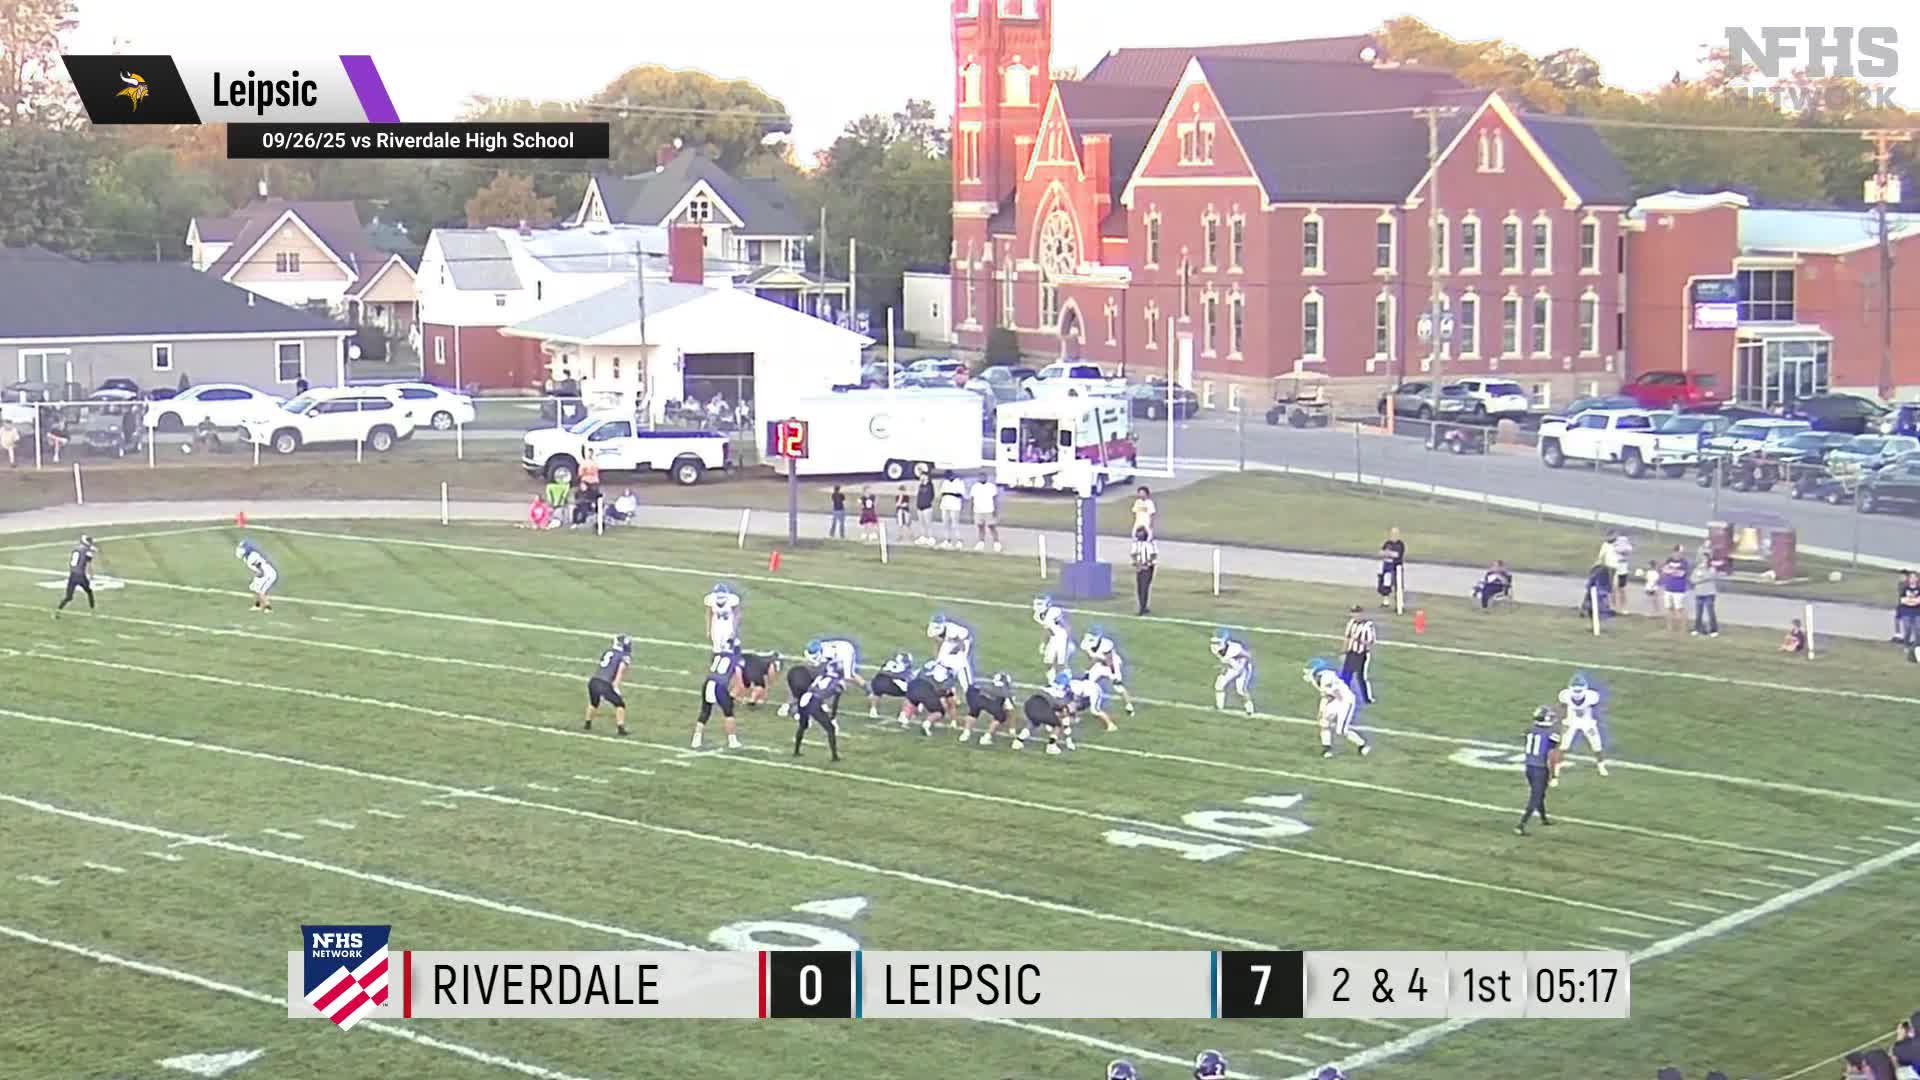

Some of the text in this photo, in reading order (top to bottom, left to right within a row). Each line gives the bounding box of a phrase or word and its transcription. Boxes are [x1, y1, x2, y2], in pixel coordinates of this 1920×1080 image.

[778, 422, 803, 455] 12
[710, 655, 731, 675] 10
[1526, 733, 1541, 756] 11
